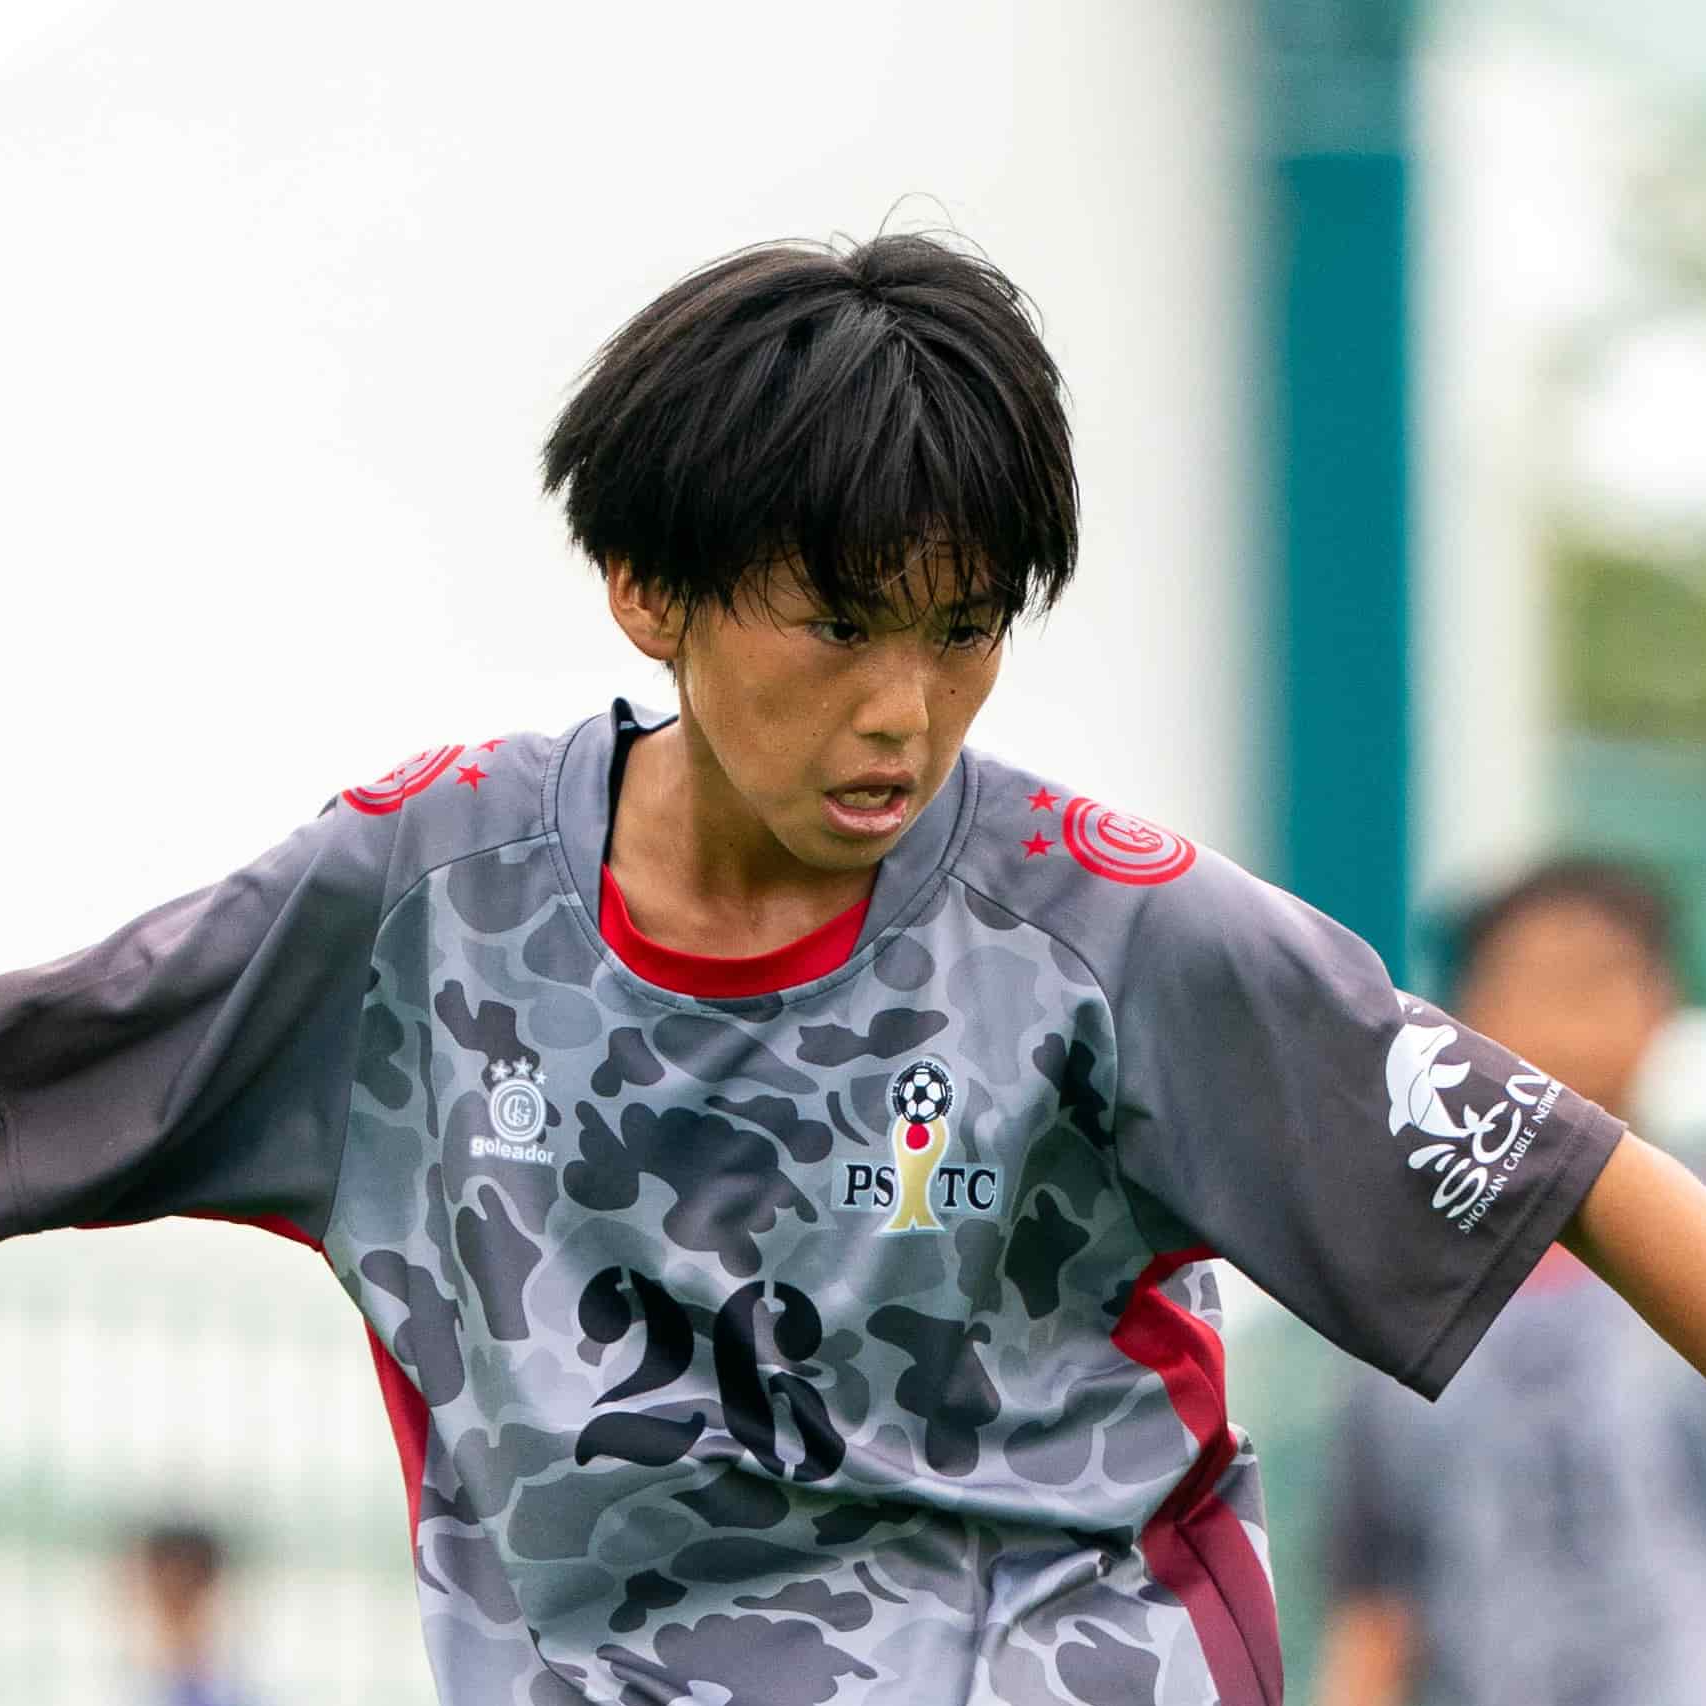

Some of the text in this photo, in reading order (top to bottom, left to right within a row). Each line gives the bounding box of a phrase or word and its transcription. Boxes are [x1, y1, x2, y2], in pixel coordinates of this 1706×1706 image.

[470, 1136, 557, 1164] goleador
[1458, 1173, 1510, 1234] SHONAN
[1502, 1125, 1538, 1172] CABLE
[575, 1265, 847, 1483] 26
